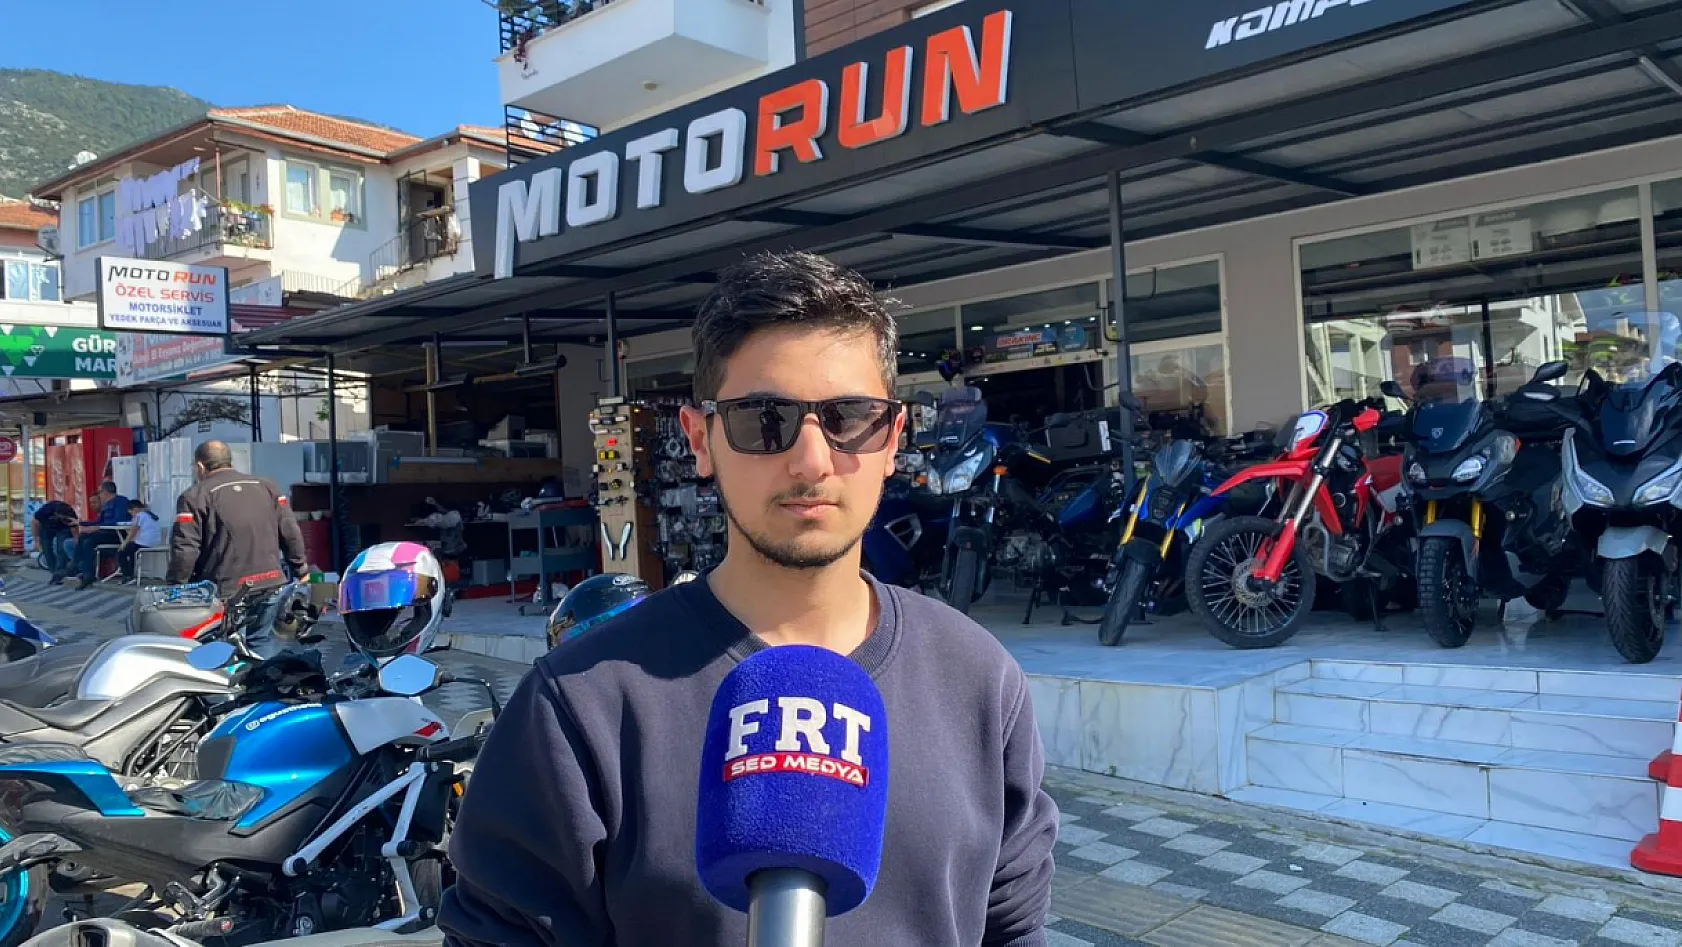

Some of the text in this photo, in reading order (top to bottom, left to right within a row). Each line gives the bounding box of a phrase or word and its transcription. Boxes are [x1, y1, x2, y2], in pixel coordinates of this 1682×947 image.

[108, 265, 216, 285] MOTO RUN
[115, 283, 215, 303] ÖZEL SERVİS
[129, 302, 203, 316] MOTORSİKLET
[109, 314, 222, 328] YEDEK PARÇA VE AKSESUAR
[725, 697, 871, 765] FRT
[731, 755, 864, 785] SED MEDYA
